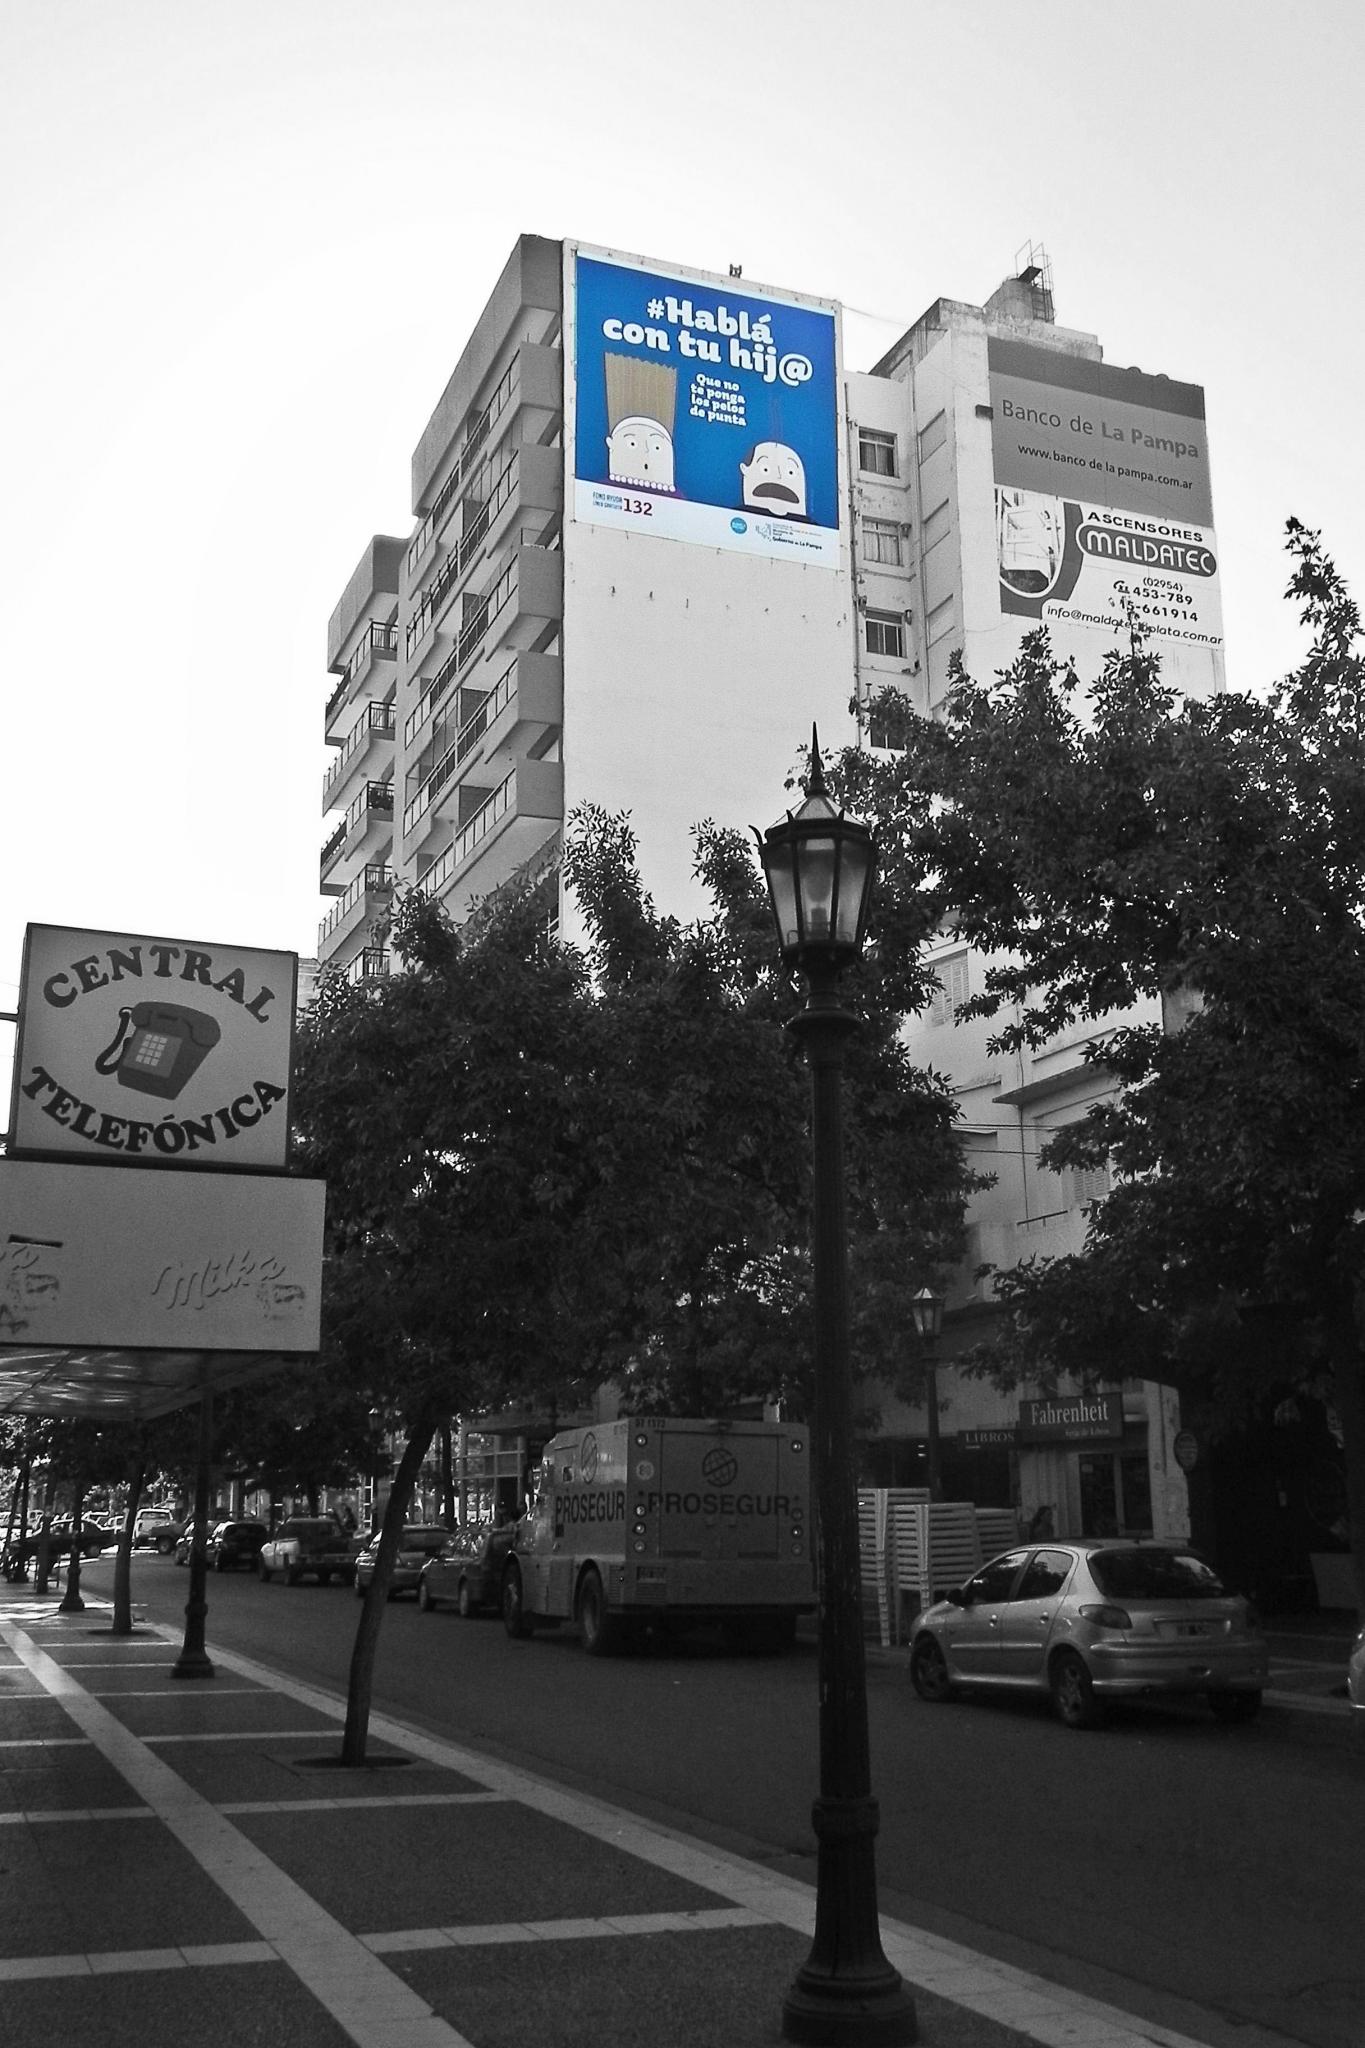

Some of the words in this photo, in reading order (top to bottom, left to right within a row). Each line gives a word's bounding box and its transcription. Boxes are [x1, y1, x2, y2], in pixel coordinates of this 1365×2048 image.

[647, 296, 774, 344] #Hablá
[602, 318, 671, 352] con
[677, 329, 722, 363] tu
[729, 338, 814, 388] hij@
[690, 383, 704, 395] te
[706, 388, 746, 405] ponga
[696, 373, 721, 387] Que
[723, 381, 740, 391] no
[689, 405, 706, 418] de
[707, 410, 747, 426] punta
[691, 393, 710, 407] los
[712, 401, 745, 415] pelos
[1002, 399, 1061, 428] Banco
[1069, 415, 1094, 435] de
[1101, 421, 1125, 442] La
[1131, 427, 1199, 459] Pampa
[1018, 444, 1086, 467] www.banco
[1089, 458, 1103, 471] de
[1105, 461, 1115, 474] la
[1117, 466, 1193, 490] pampa.com.ar
[623, 497, 653, 517] 132
[1087, 511, 1203, 542] ASCENSORES
[1086, 529, 1212, 575] MALDATEC
[1133, 587, 1193, 605] 453-789
[1143, 577, 1184, 593] (02954)
[1119, 598, 1199, 623] 15-661914
[43, 945, 275, 1023] CENTRAL
[21, 1066, 286, 1153] TELEFÓNICA
[1031, 1397, 1110, 1426] Fahrenheit
[965, 1431, 1016, 1444] LIBROS
[554, 1490, 625, 1525] PROSEGUR
[647, 1492, 790, 1517] PROSEGUR
